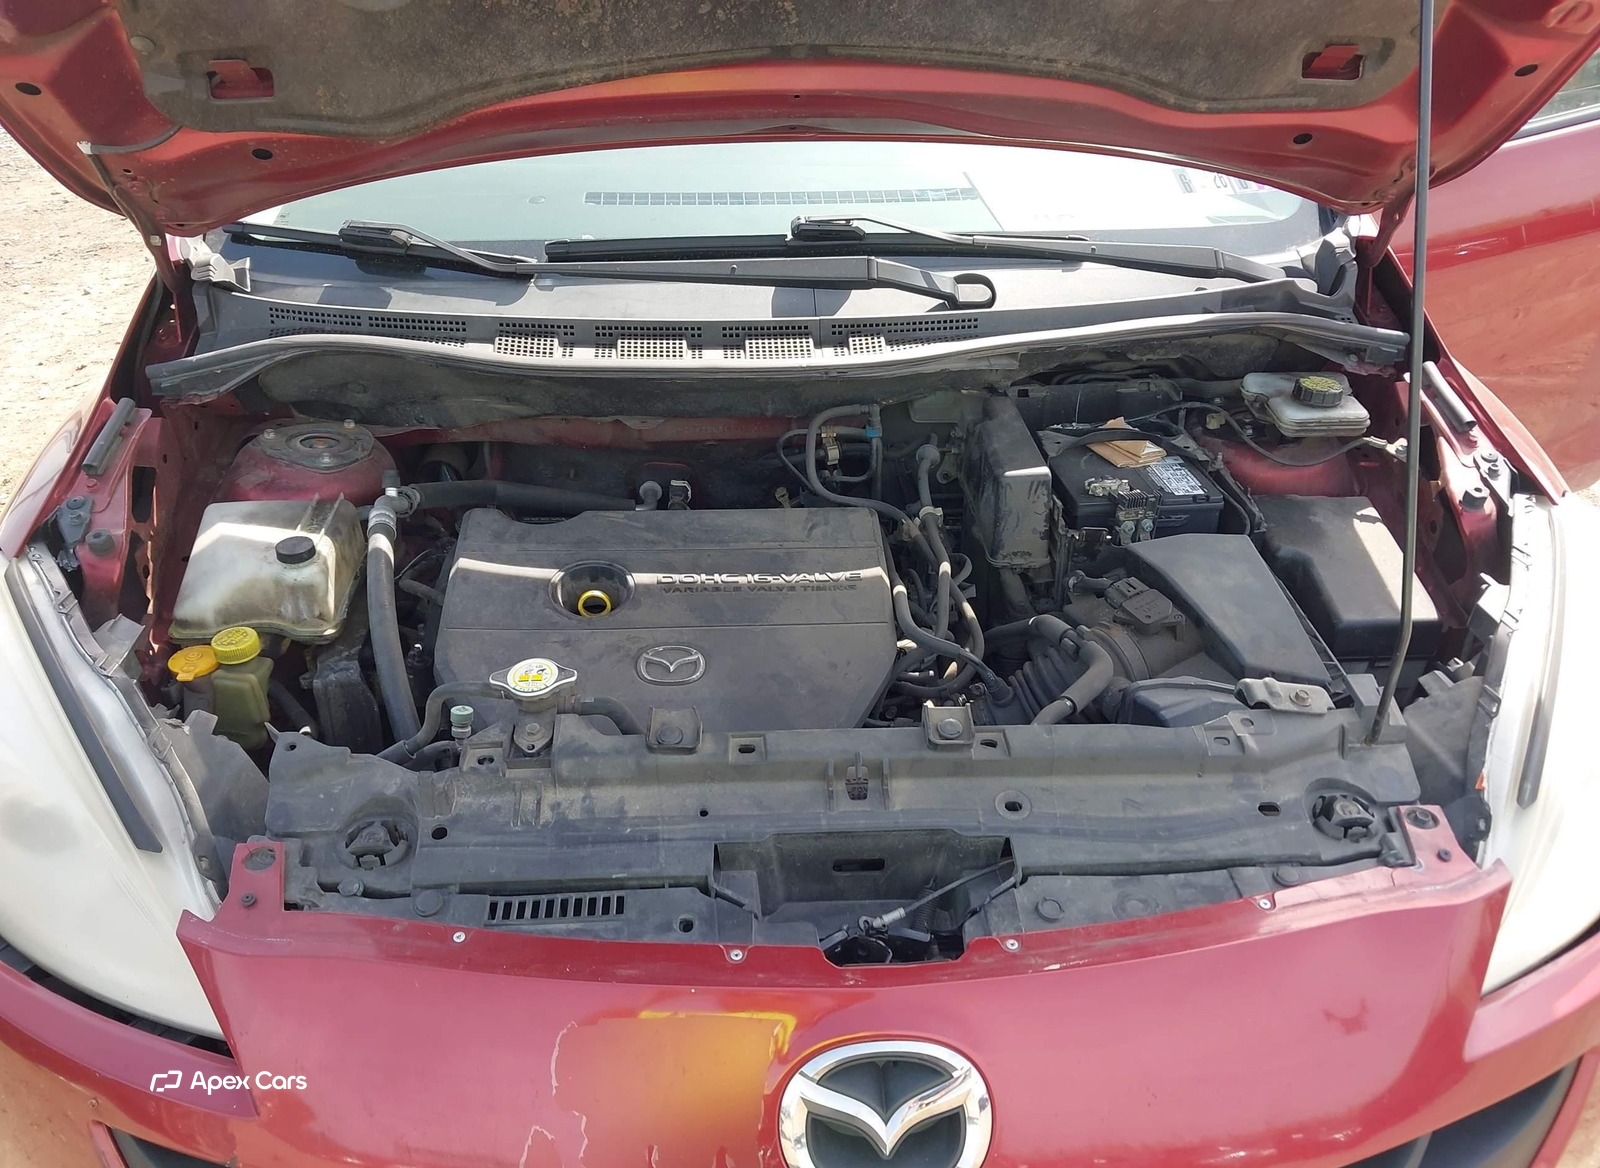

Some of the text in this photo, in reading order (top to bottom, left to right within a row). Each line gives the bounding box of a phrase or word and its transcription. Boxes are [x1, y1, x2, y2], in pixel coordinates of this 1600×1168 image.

[656, 571, 863, 585] DOHC 16-VALVE
[662, 584, 858, 594] VARIABLE VALVE TIMING
